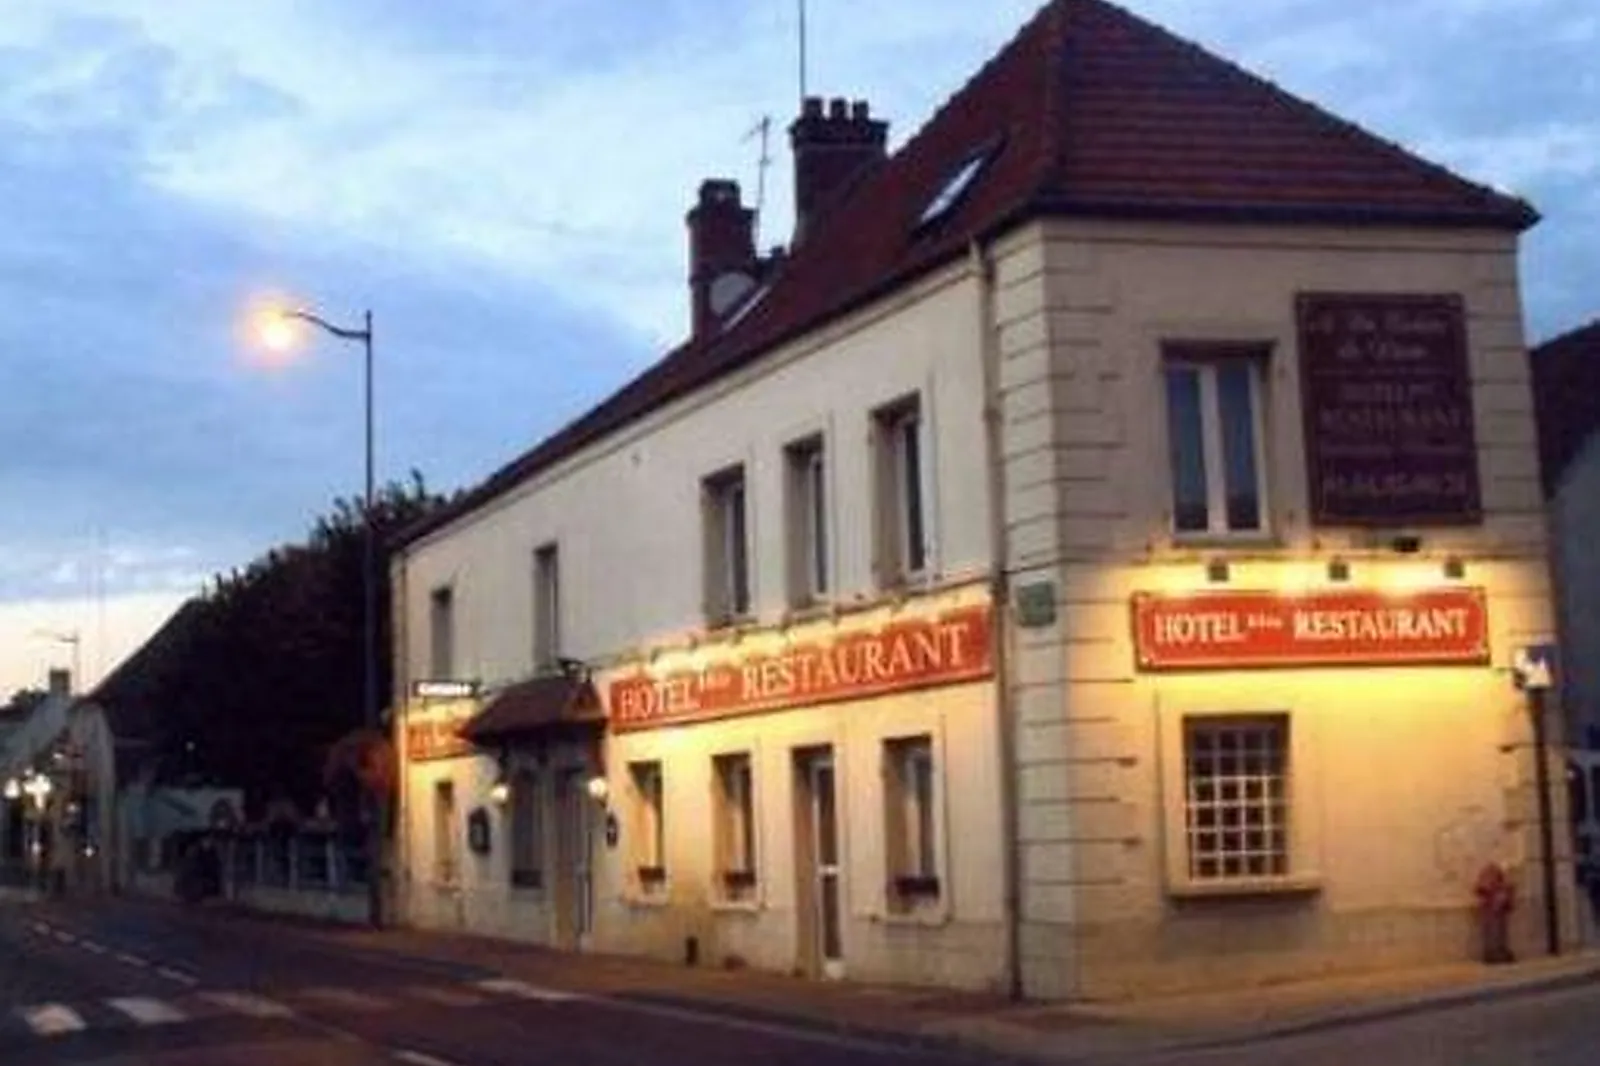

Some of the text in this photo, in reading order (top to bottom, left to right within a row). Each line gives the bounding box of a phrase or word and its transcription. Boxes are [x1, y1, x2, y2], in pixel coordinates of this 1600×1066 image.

[1154, 612, 1246, 646] HOTEL
[1294, 608, 1468, 642] RESTAURANT
[742, 622, 969, 700] RESTAURANT
